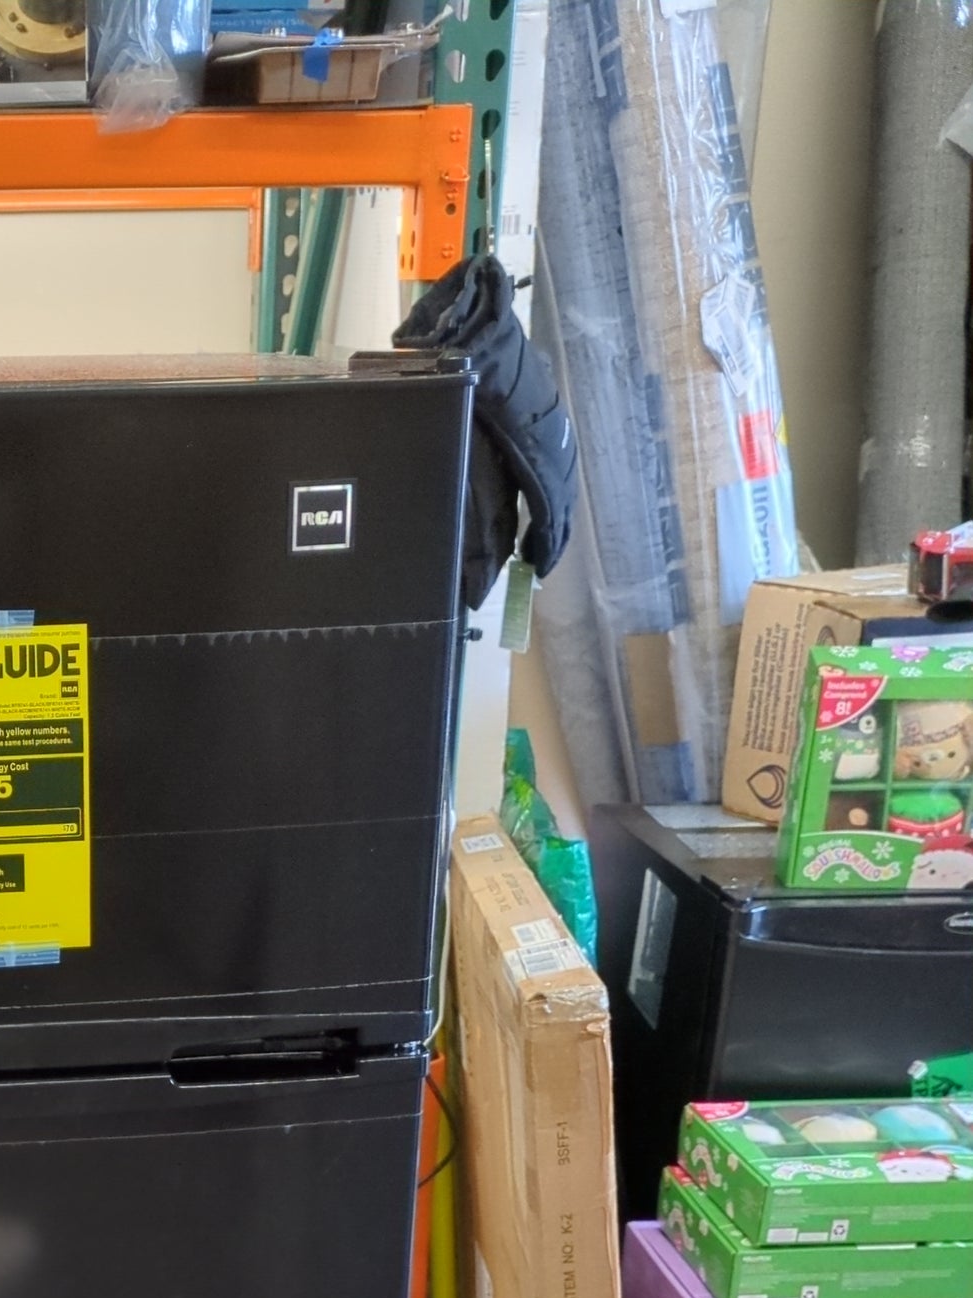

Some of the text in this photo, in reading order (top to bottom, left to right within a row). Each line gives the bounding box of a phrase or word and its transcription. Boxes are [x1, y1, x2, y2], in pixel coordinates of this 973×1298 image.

[300, 510, 343, 527] RCA
[5, 727, 32, 738] yellow
[32, 726, 71, 736] numbers.
[9, 762, 29, 772] Cost
[4, 881, 17, 889] Use
[559, 1212, 574, 1235] K-2
